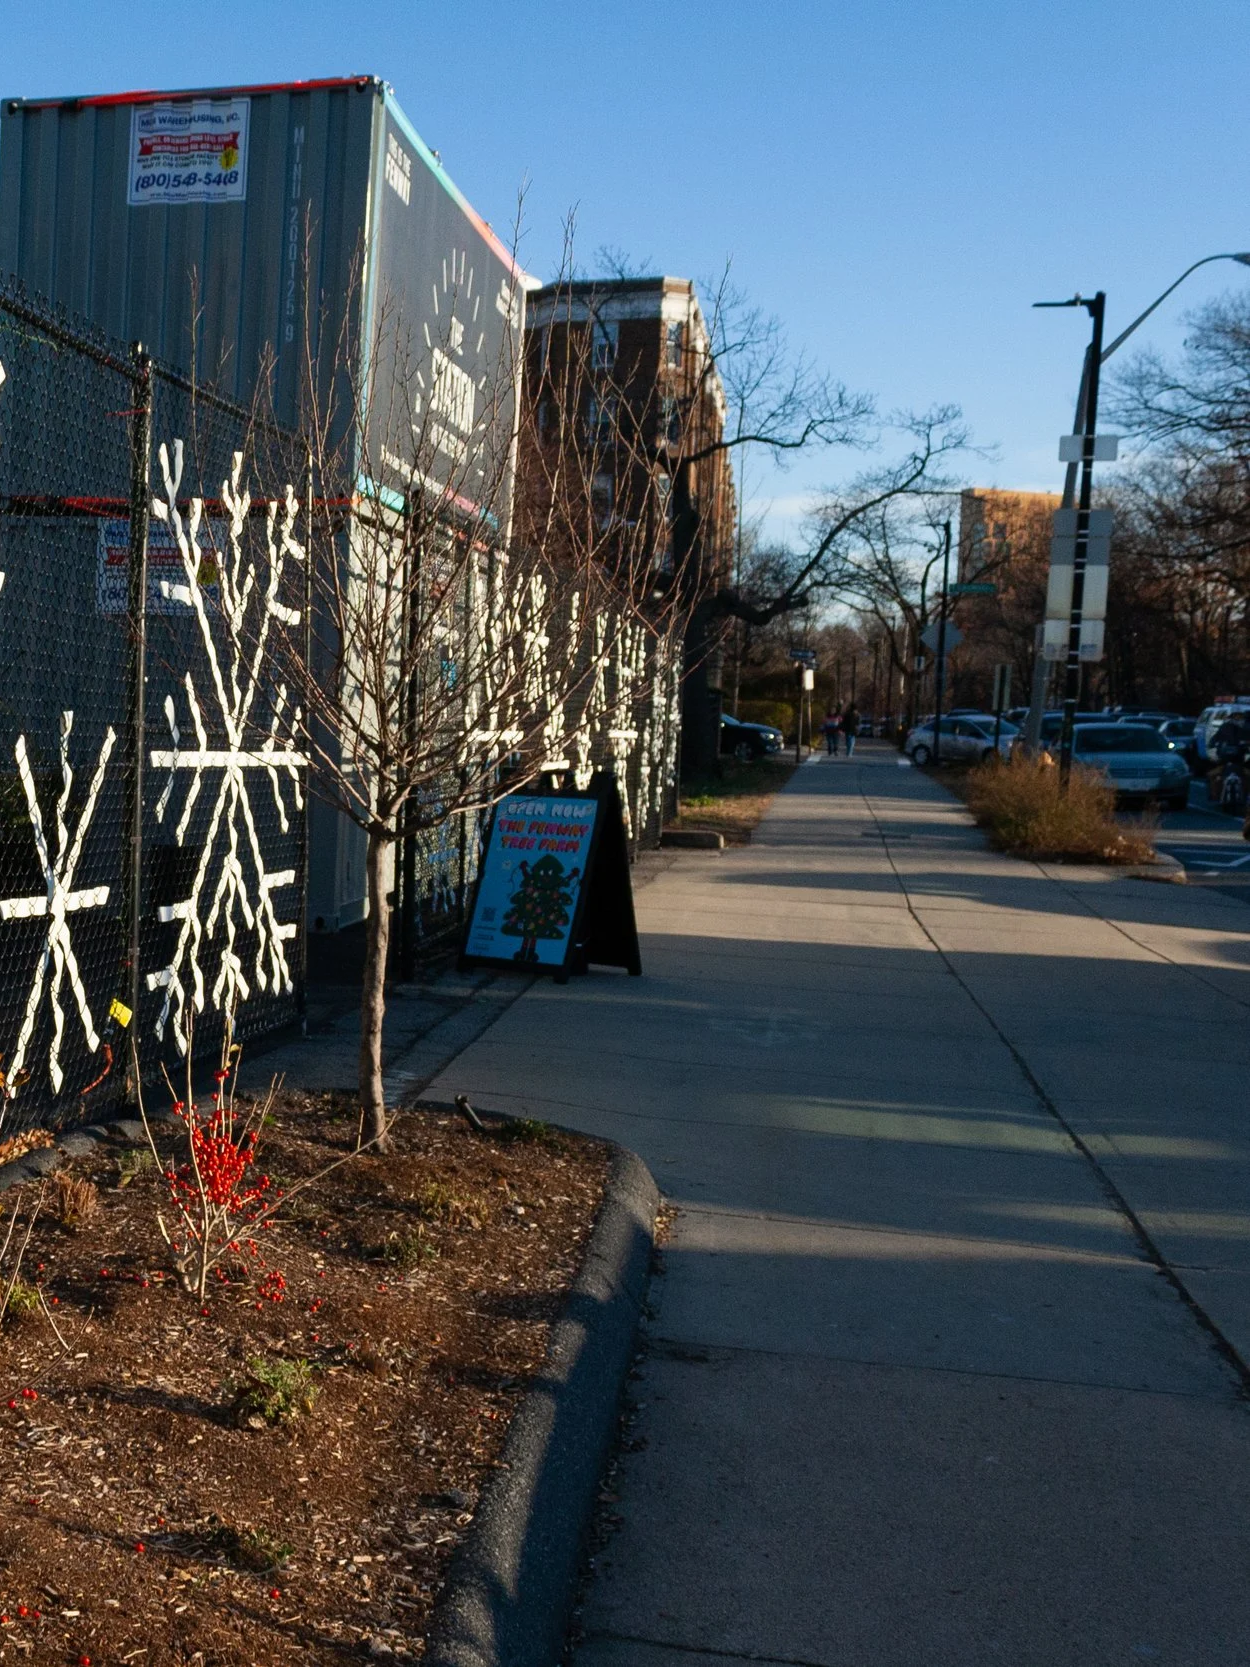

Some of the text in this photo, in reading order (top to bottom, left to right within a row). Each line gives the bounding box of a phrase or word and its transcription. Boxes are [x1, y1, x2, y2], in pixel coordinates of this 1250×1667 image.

[508, 802, 587, 818] OPEN NOW
[499, 819, 590, 838] THE FENWAY
[501, 835, 580, 853] TREE FARM
